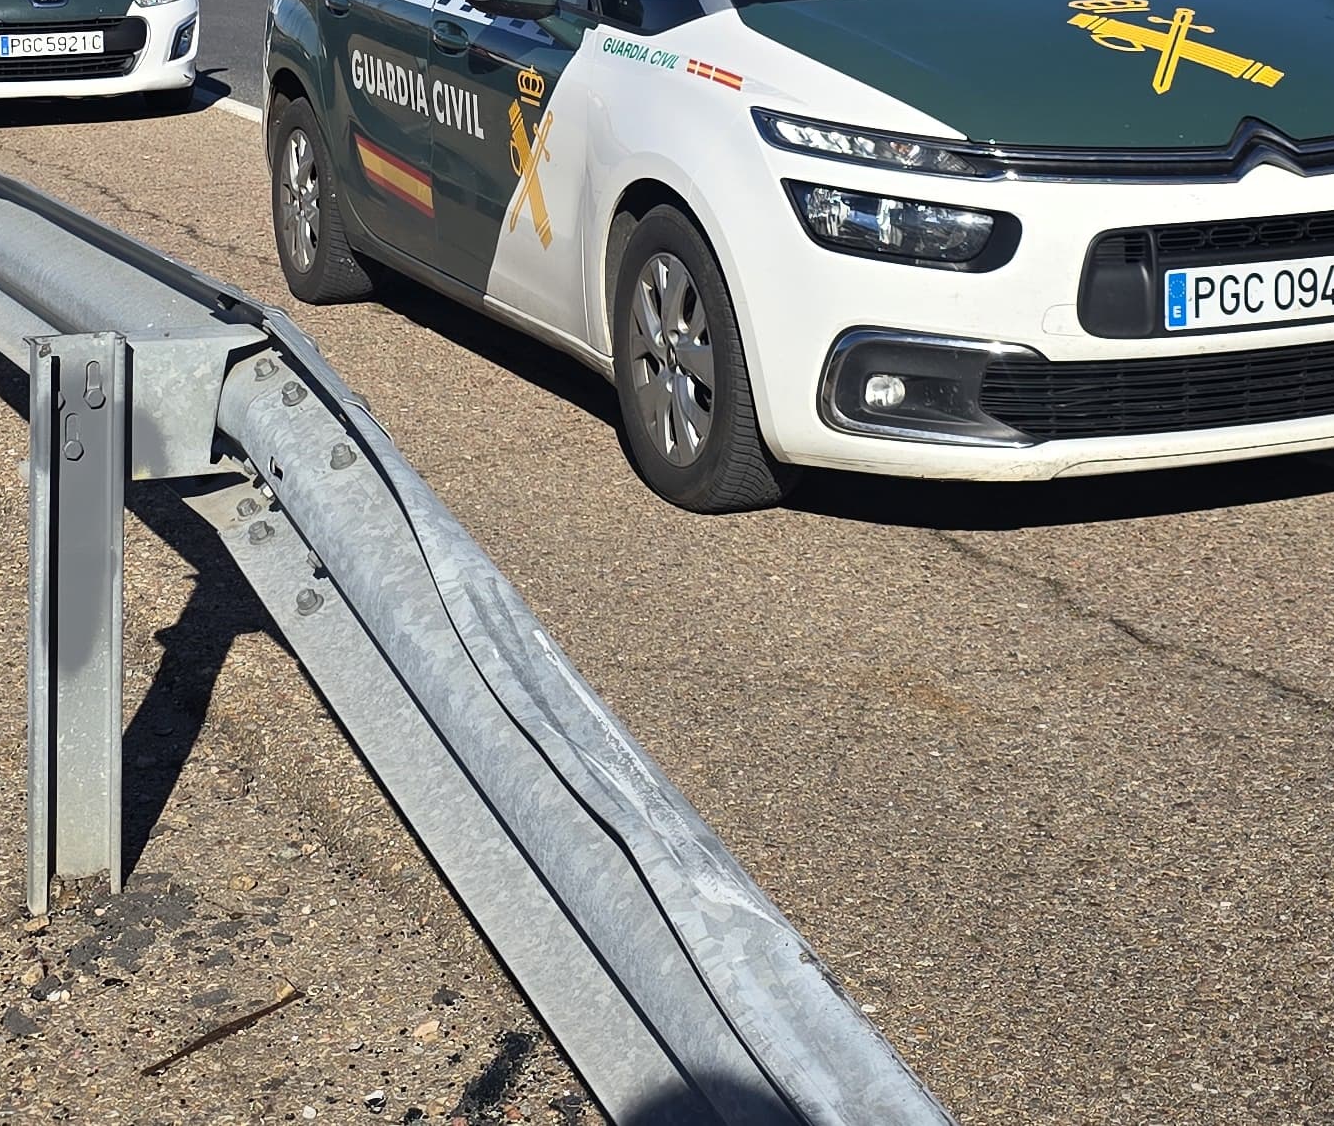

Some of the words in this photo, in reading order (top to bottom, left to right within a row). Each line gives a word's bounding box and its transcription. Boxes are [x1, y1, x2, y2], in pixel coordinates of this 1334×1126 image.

[10, 37, 43, 53] PGC
[46, 35, 87, 52] 5921
[602, 37, 650, 62] GUARDIA
[650, 50, 680, 69] CIVIL
[351, 49, 429, 117] GUARDIA
[432, 79, 485, 140] CIVIL
[1172, 305, 1182, 318] E
[1194, 274, 1264, 318] PGC
